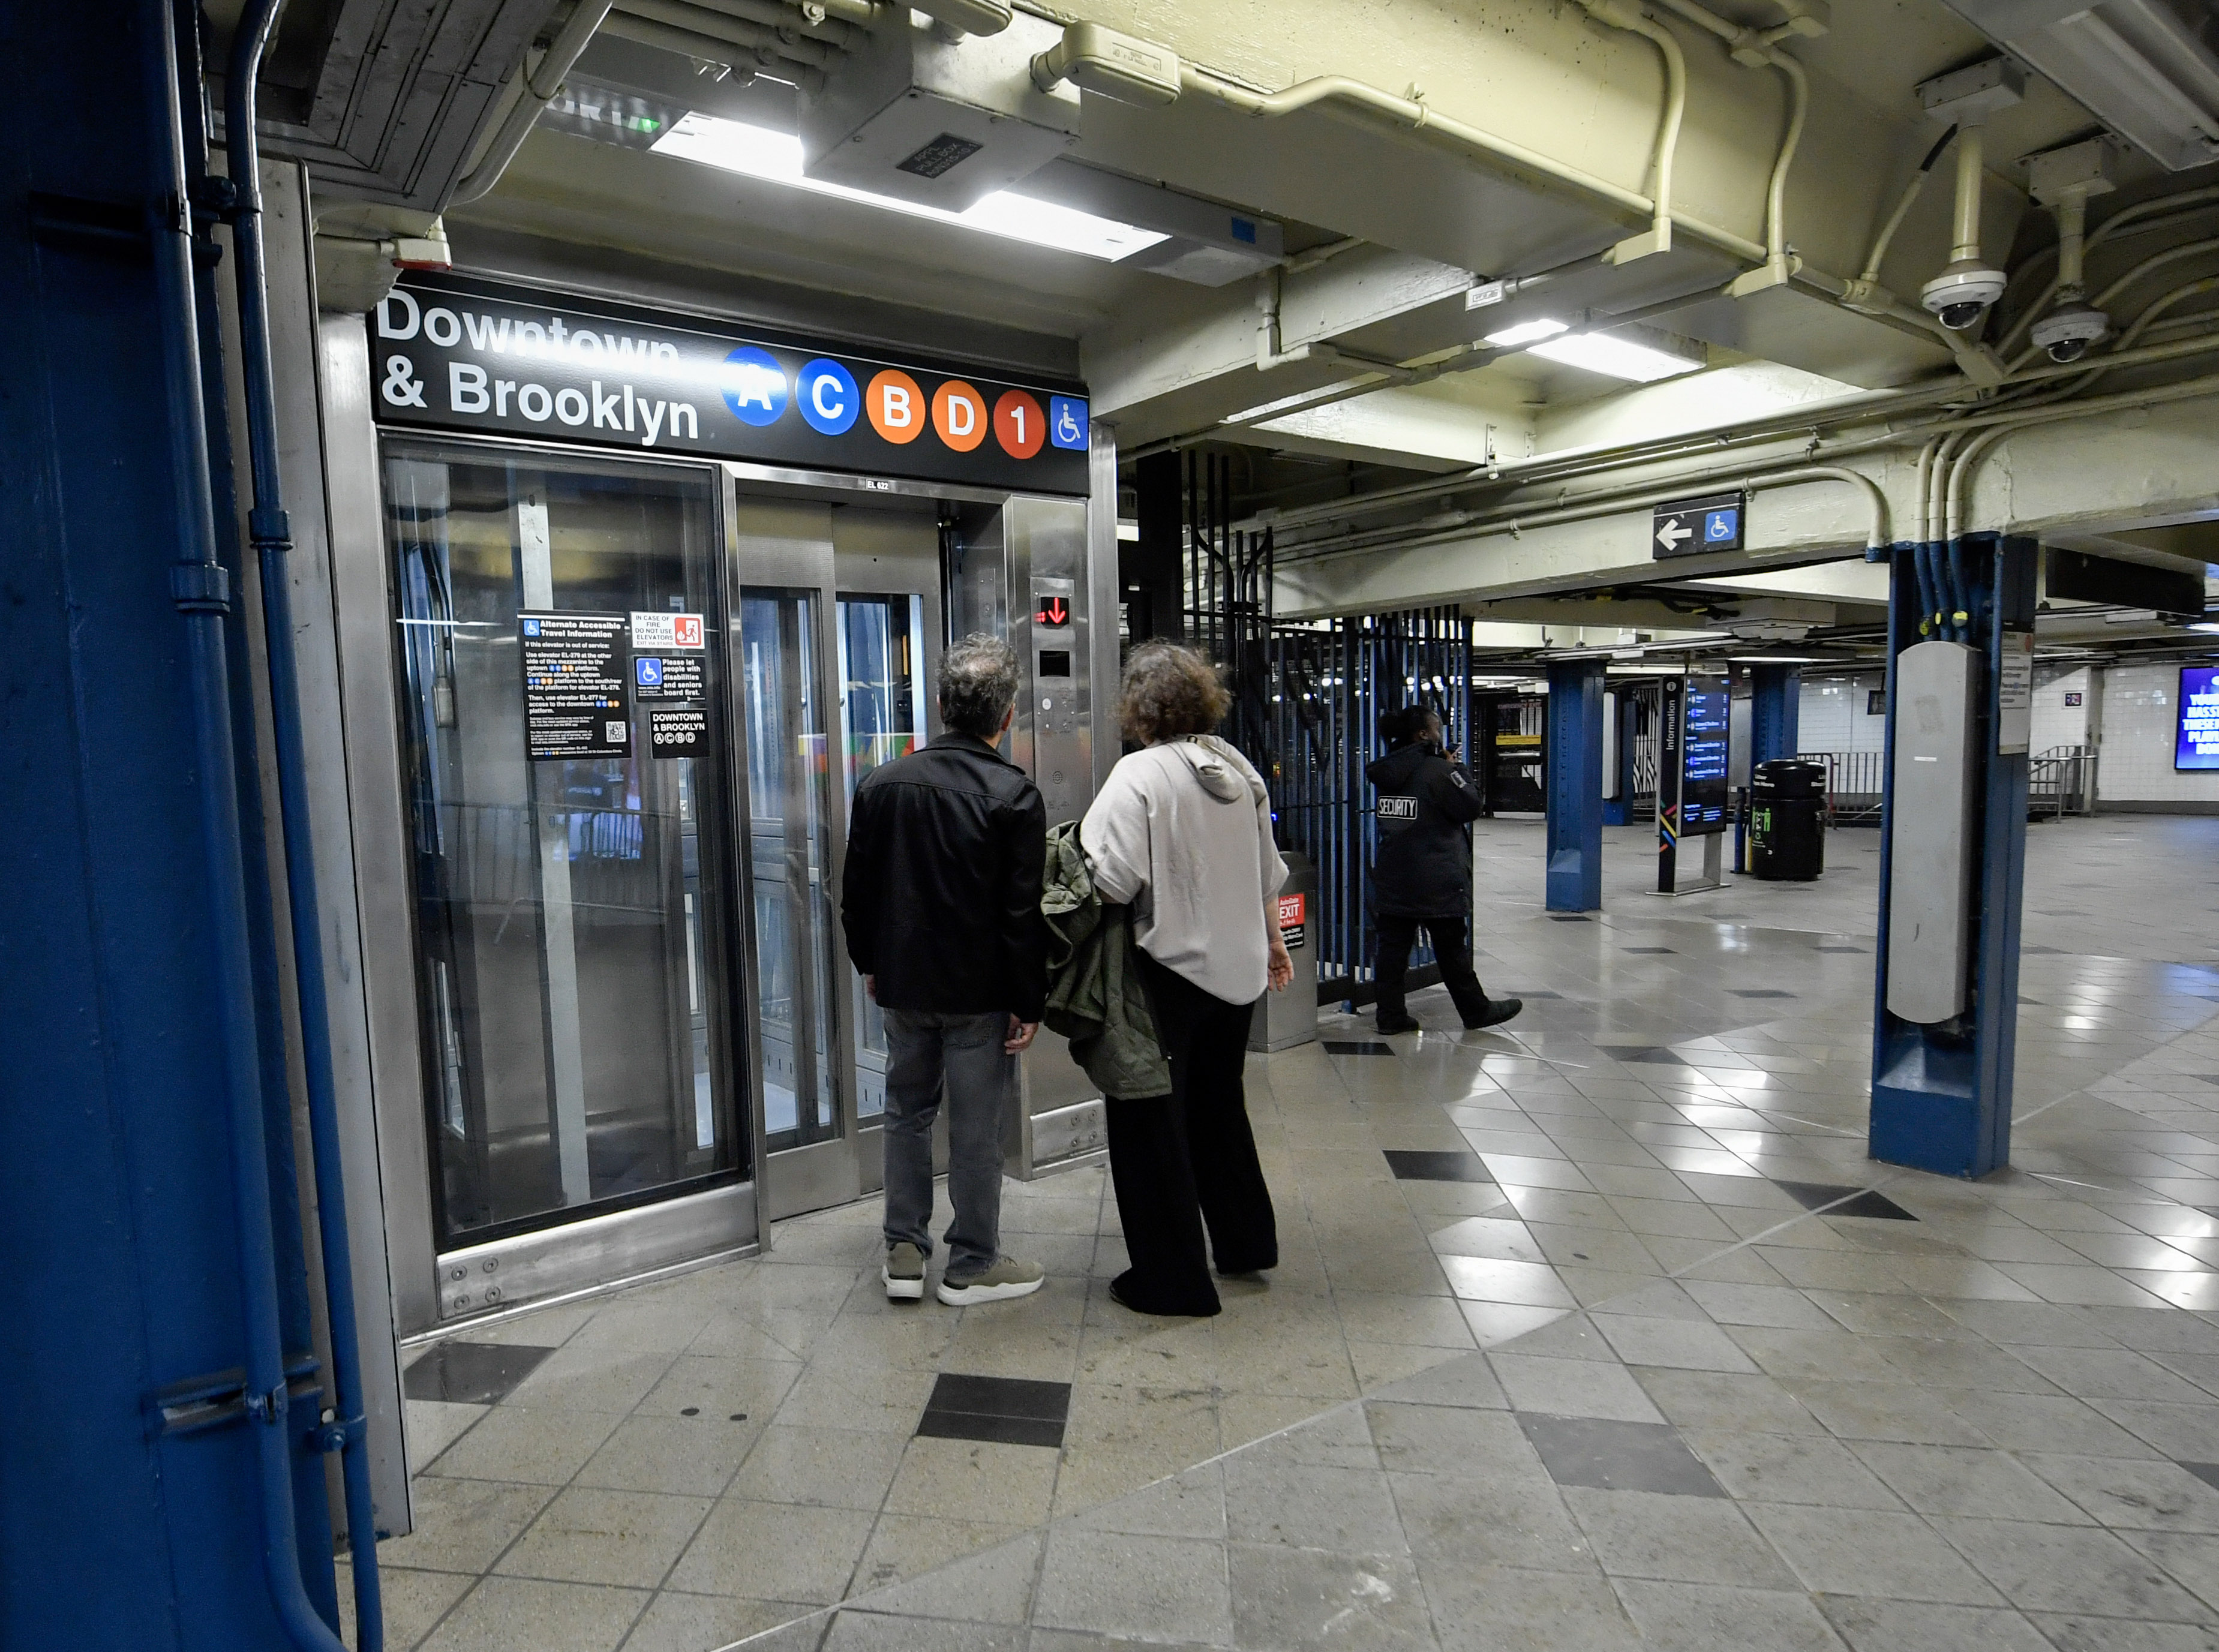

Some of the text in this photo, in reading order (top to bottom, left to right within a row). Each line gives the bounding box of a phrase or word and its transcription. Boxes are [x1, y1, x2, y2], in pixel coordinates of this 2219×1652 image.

[377, 289, 680, 374] Downtown
[382, 355, 698, 446] & Brooklyn
[737, 364, 1025, 443] A C B D 1
[877, 482, 888, 490] 622
[540, 620, 621, 630] Alternate Accessible
[653, 713, 703, 722] DOWNTOWN
[1666, 699, 1675, 750] Information
[660, 722, 705, 731] BROOKLYN
[1379, 798, 1415, 816] SECURITY
[1280, 904, 1300, 919] EXIT
